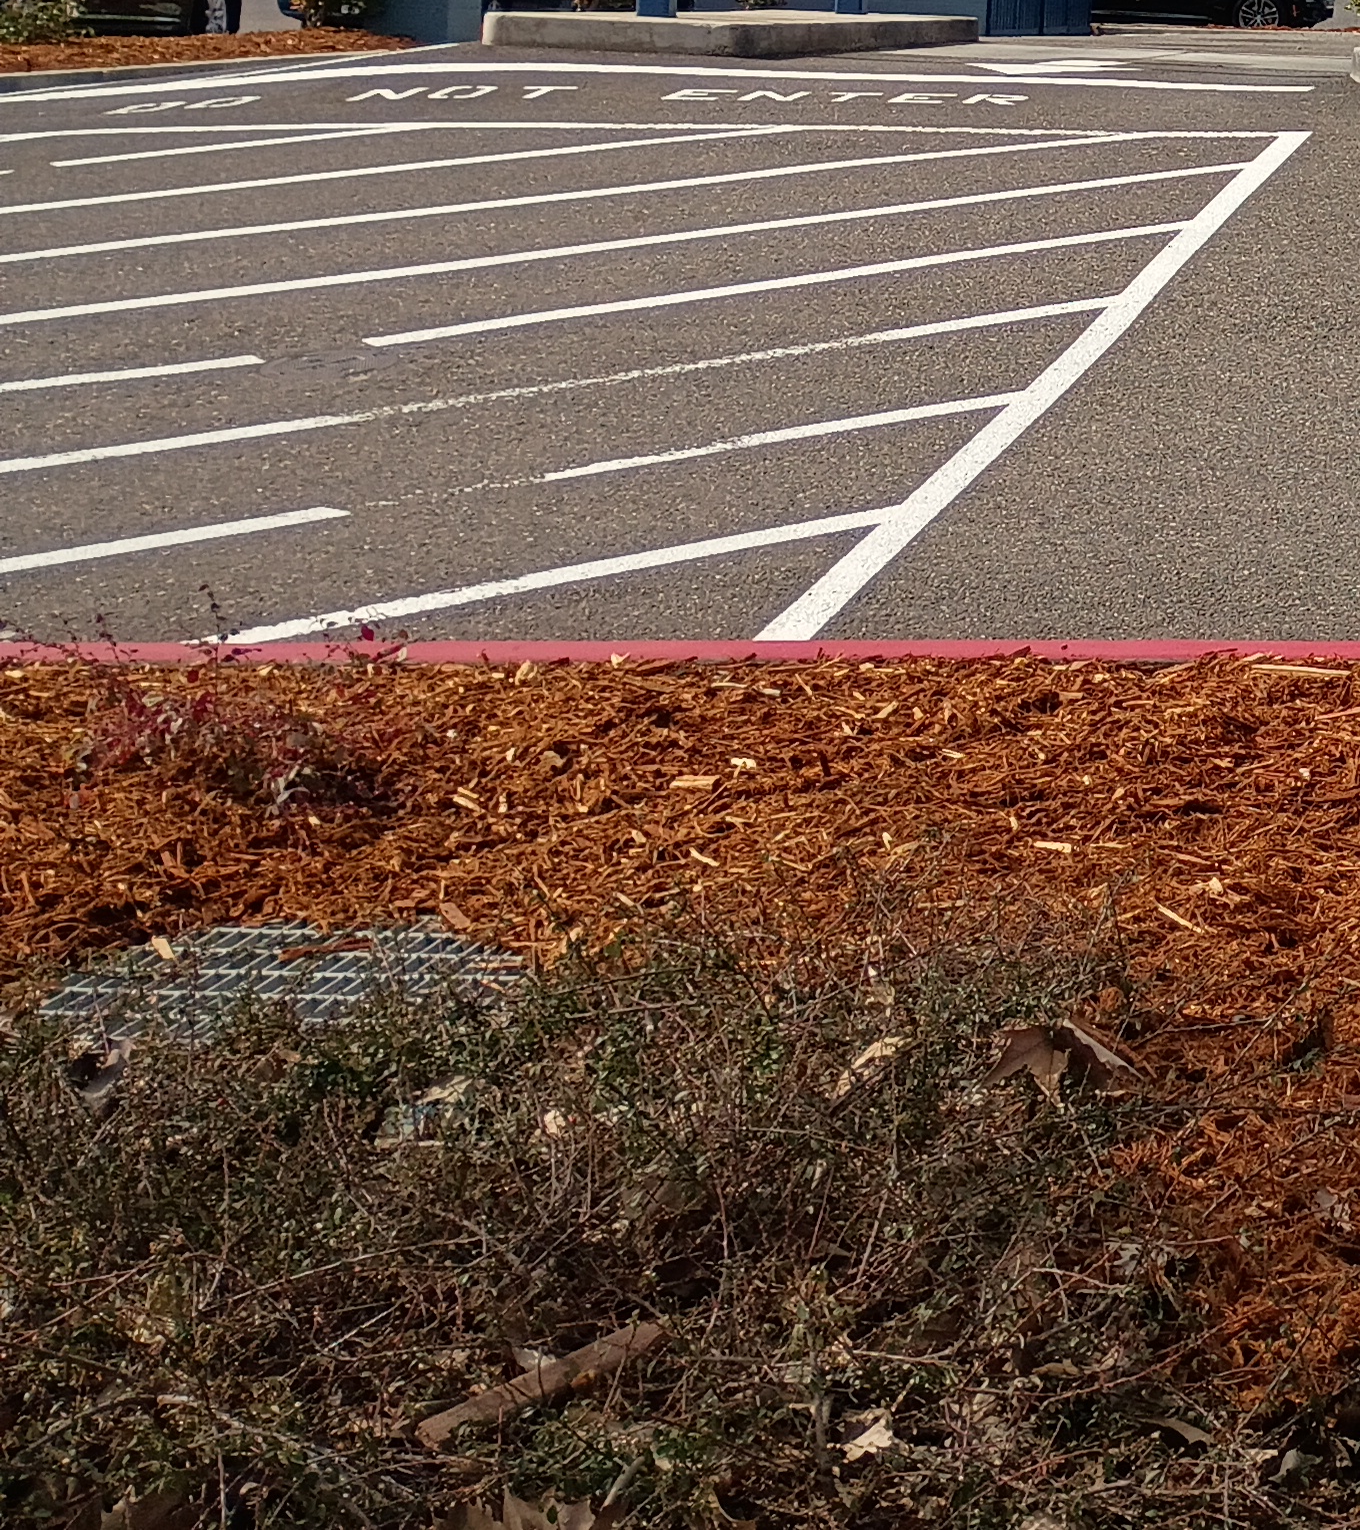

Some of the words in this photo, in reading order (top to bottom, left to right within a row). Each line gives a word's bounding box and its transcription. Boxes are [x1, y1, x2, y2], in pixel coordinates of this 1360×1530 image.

[101, 94, 262, 115] DO
[346, 85, 578, 102] NOT
[660, 88, 1030, 106] ENTER
